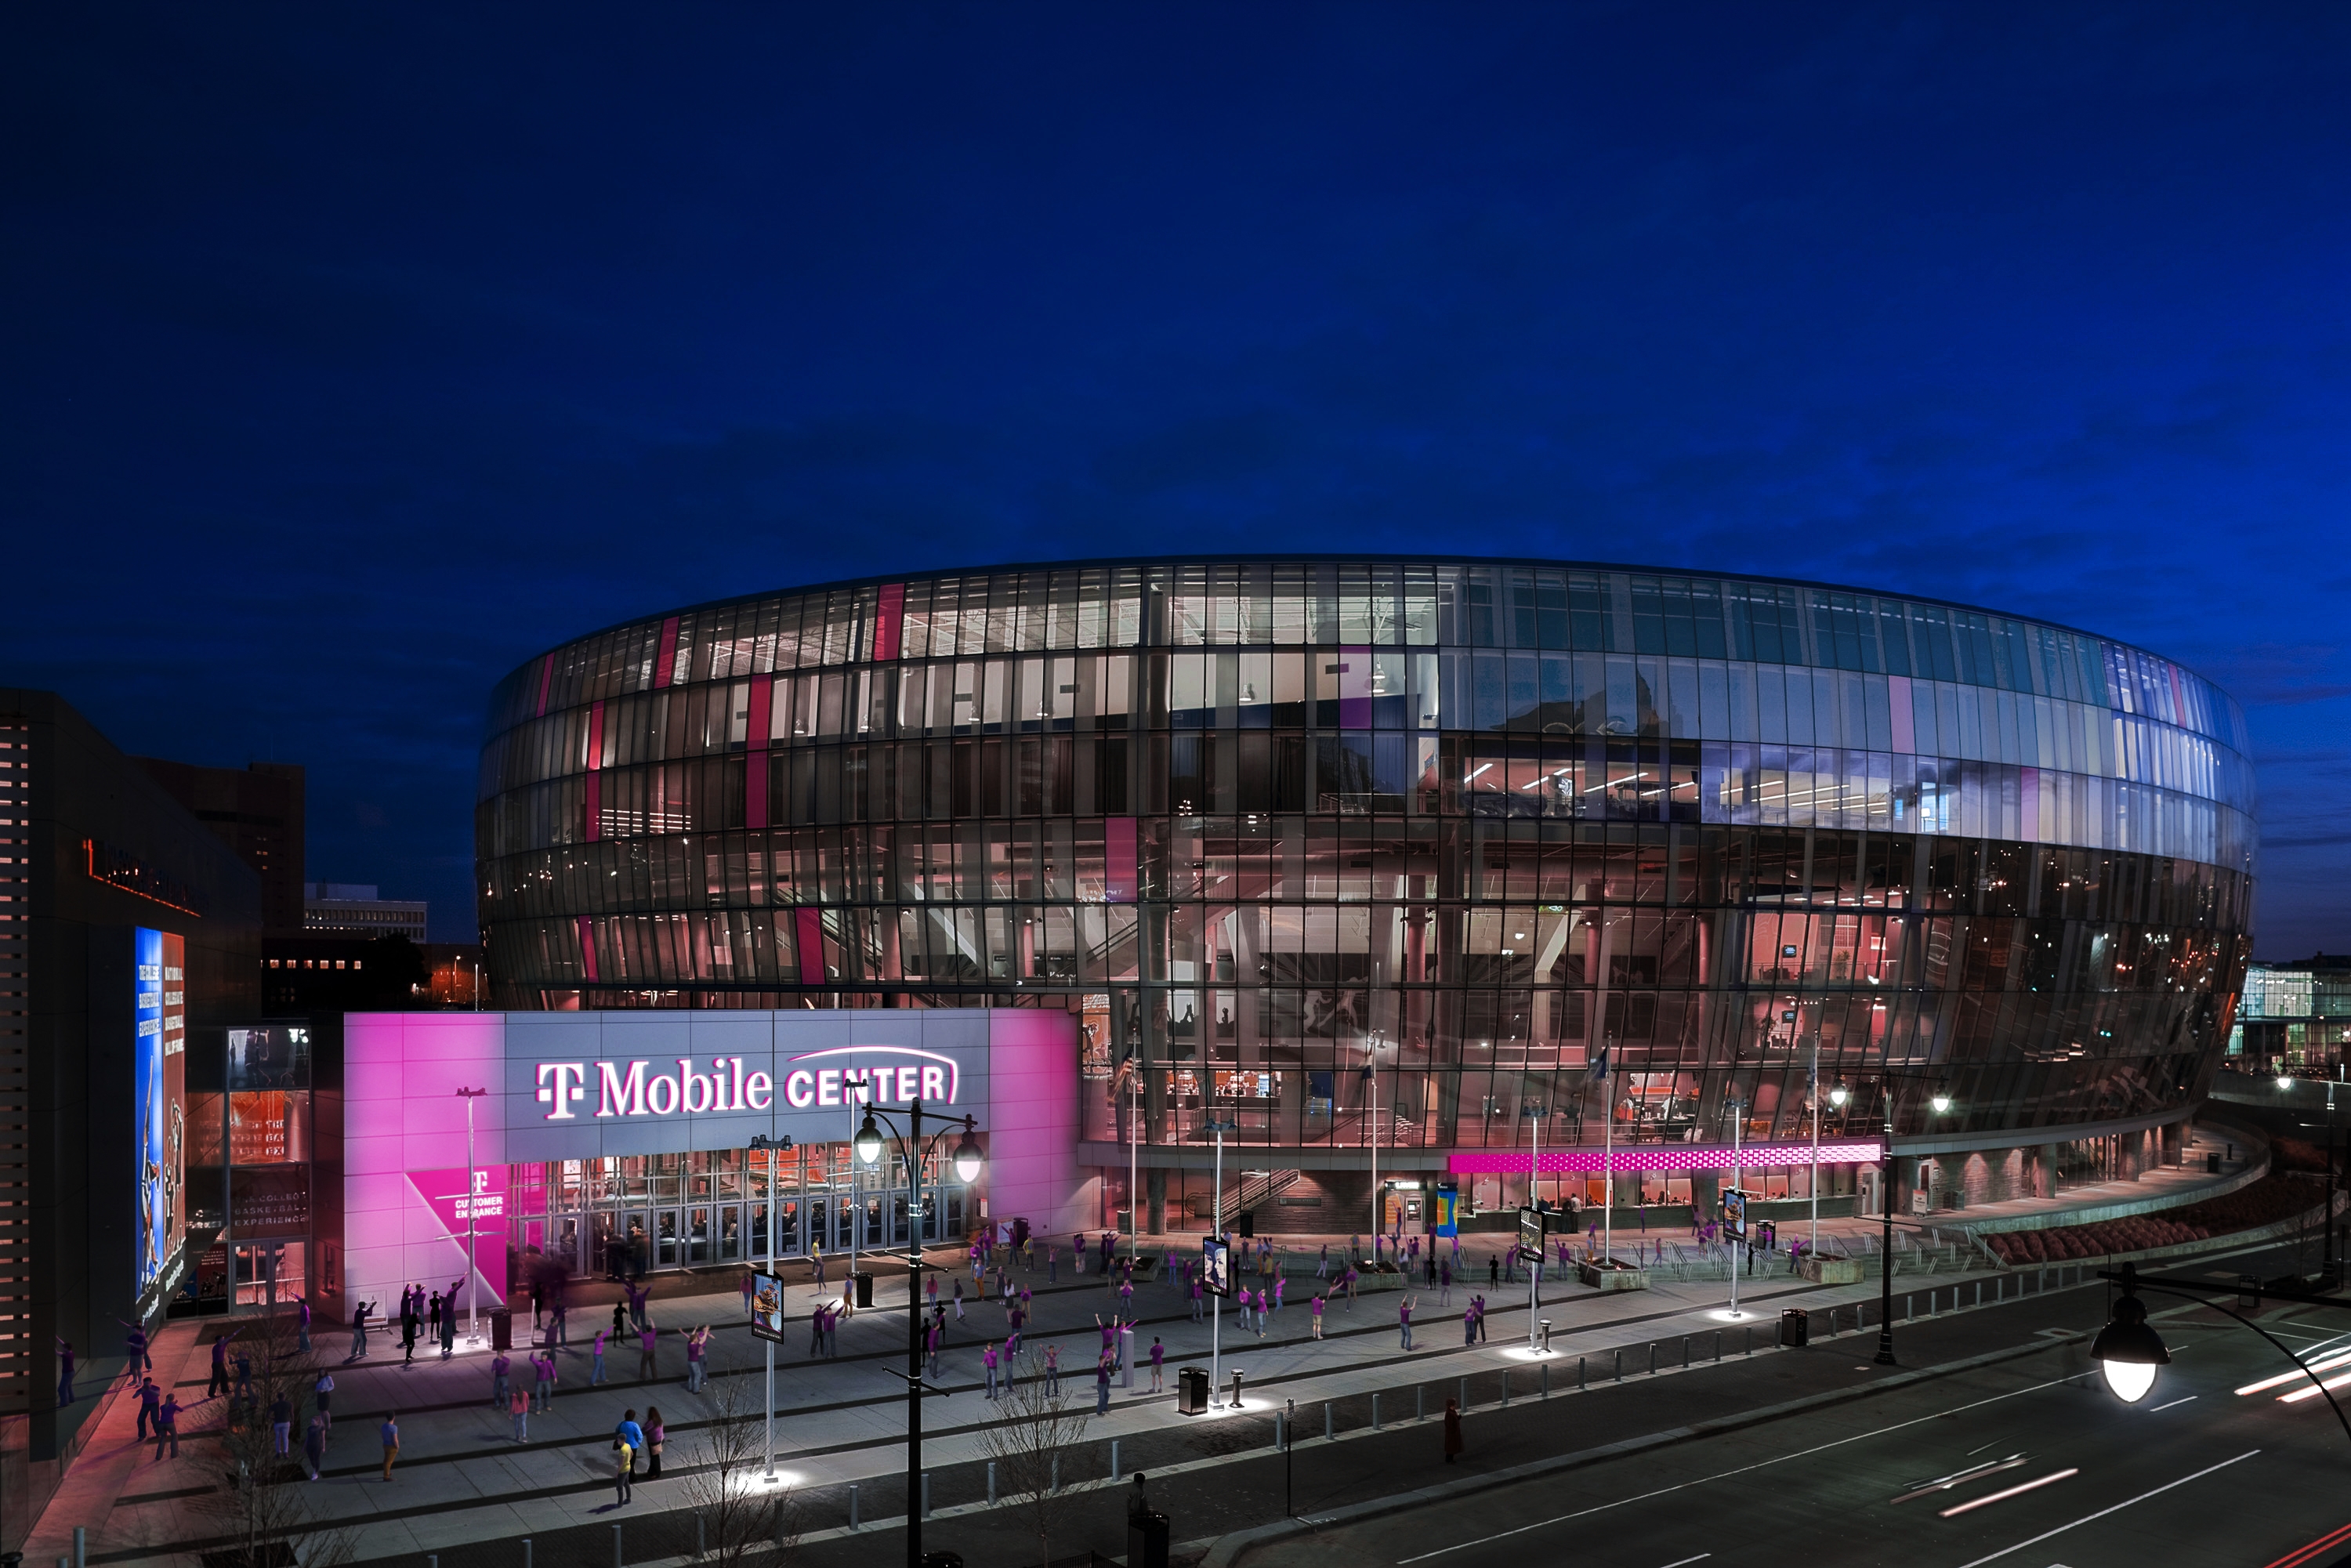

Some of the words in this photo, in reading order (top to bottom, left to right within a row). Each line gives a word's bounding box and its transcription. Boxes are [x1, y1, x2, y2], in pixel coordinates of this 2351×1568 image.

[536, 1061, 584, 1120] T
[593, 1056, 773, 1118] Mobile
[785, 1064, 945, 1109] CENTER
[455, 1196, 503, 1209] CUTOMER
[455, 1206, 503, 1219] ENANCE
